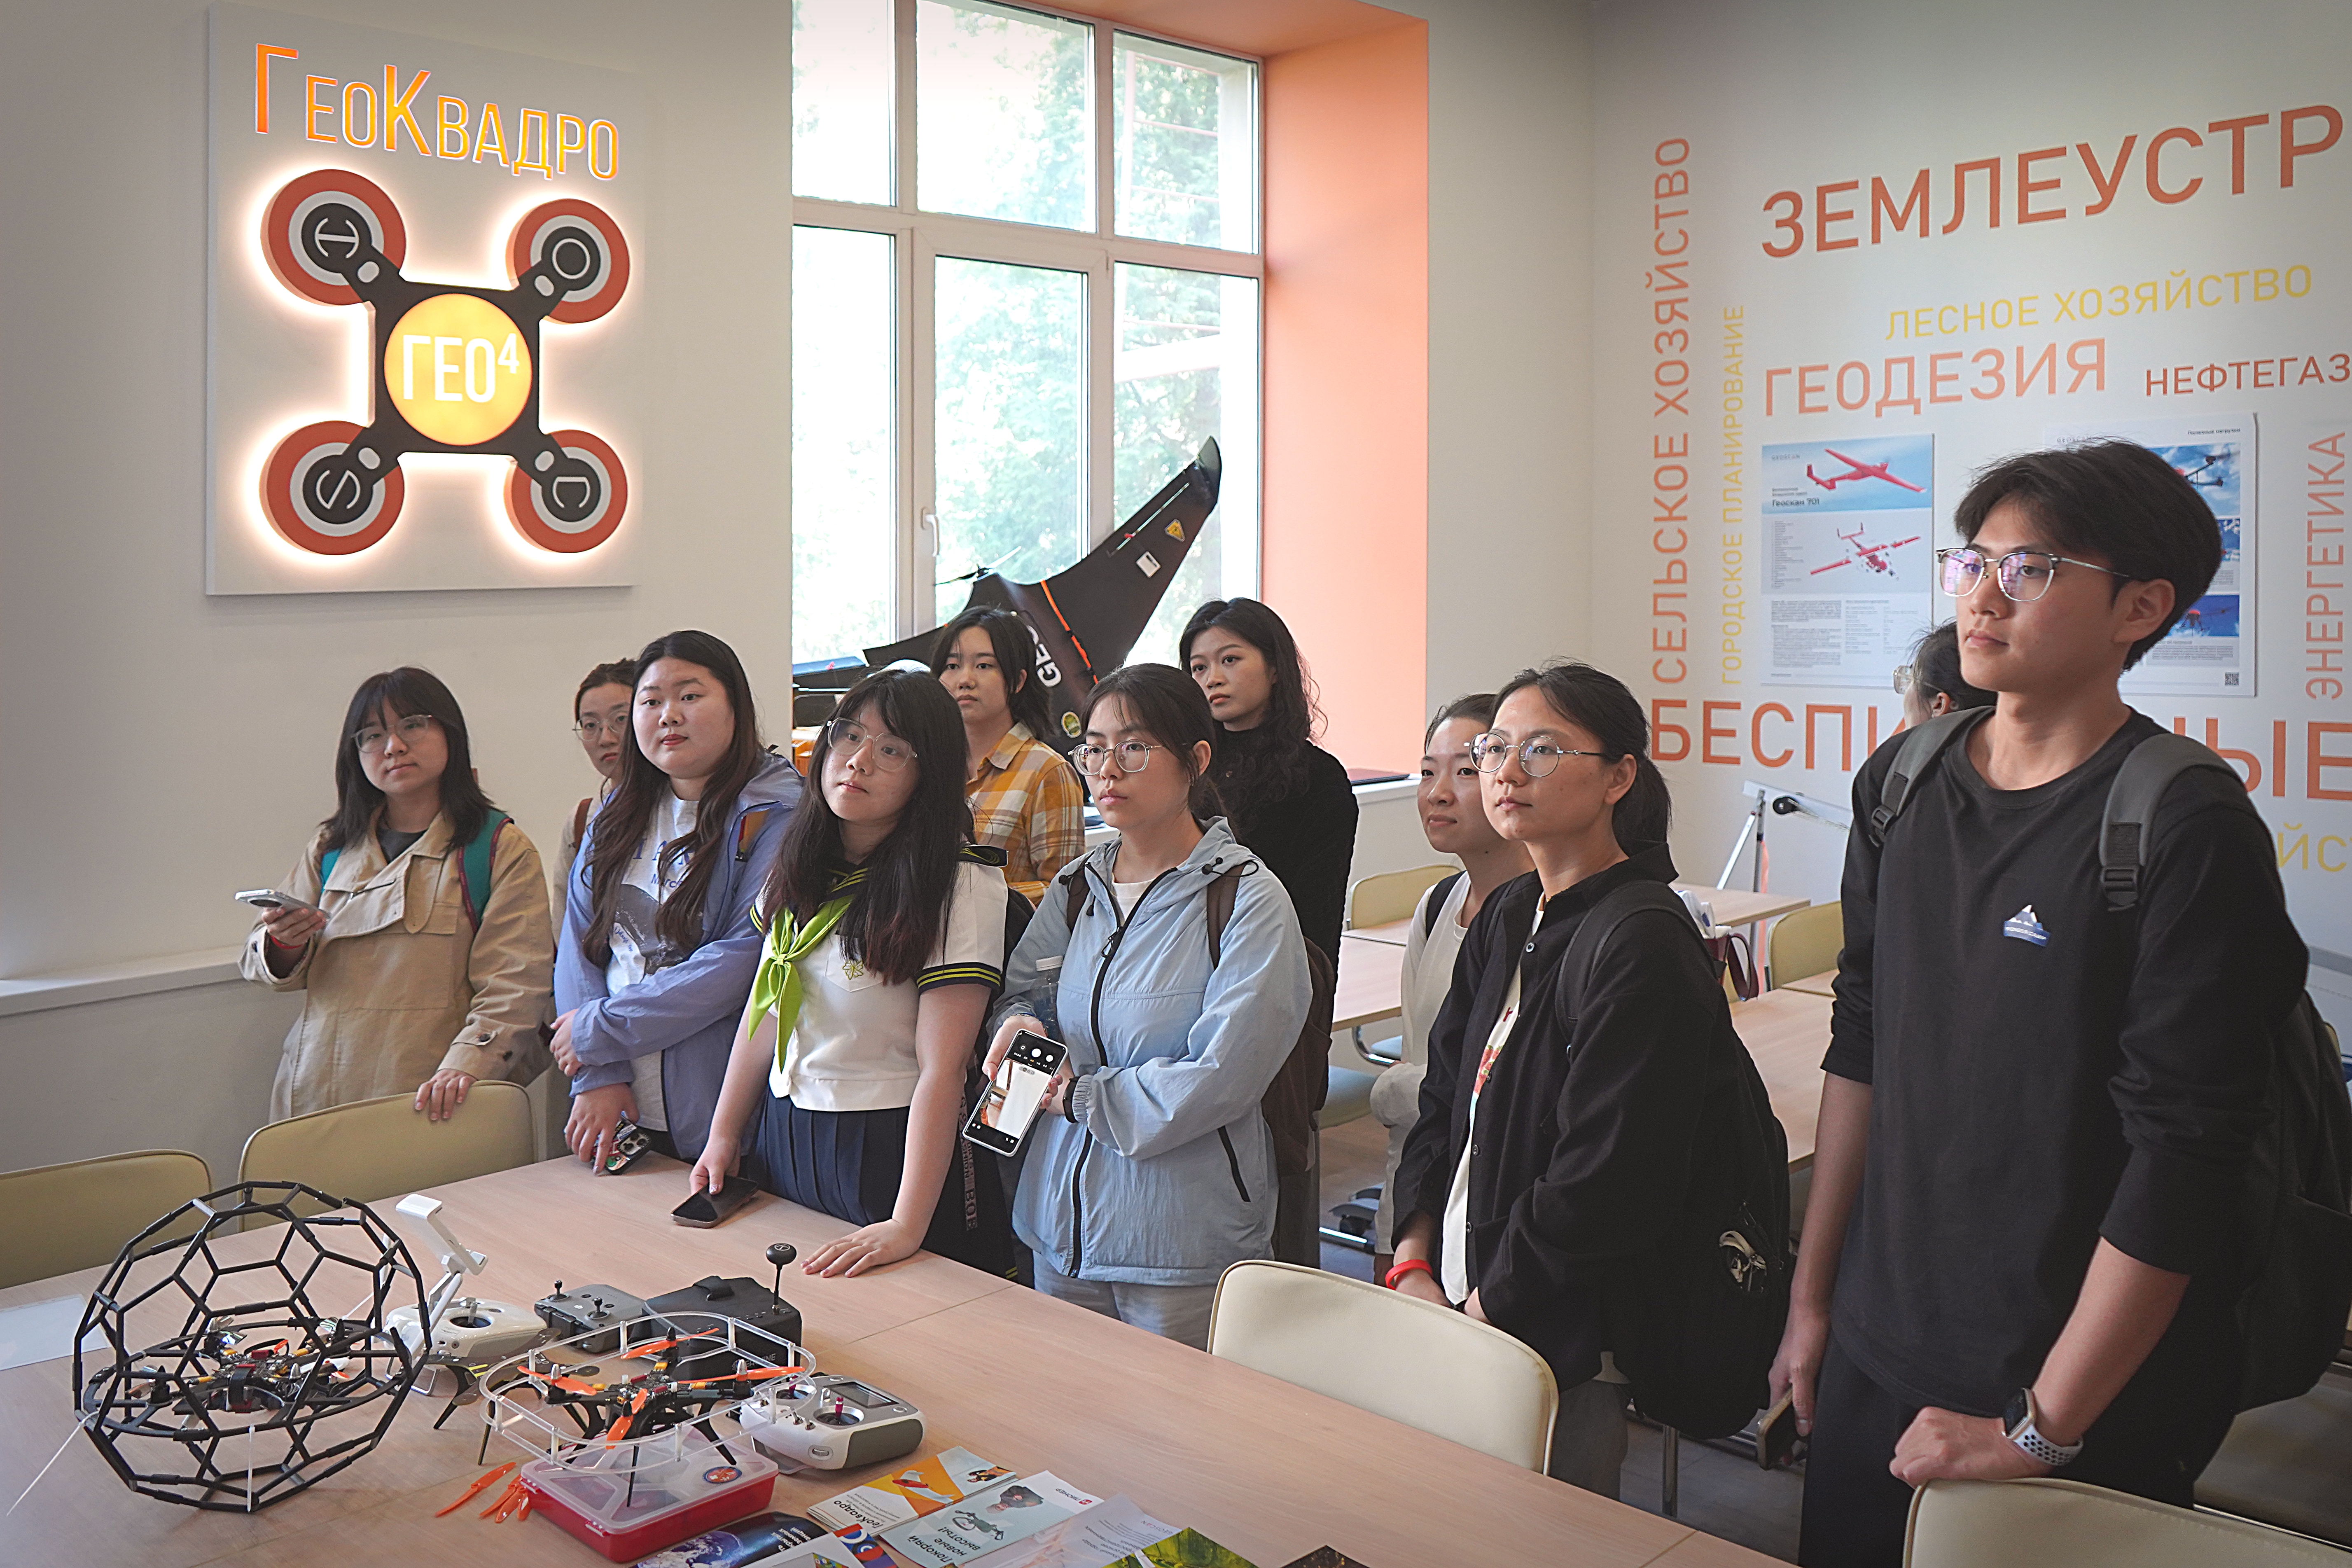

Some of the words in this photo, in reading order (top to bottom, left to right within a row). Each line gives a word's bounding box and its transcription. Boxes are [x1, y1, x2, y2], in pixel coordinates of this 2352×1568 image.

[1761, 104, 2344, 257] ЗЕМЛЕУСТР
[1645, 138, 1689, 417] ХОЗЯЙСТВО
[1885, 294, 2039, 340] ЛЕСНОЕ
[2053, 264, 2313, 323] ХОЗЯЙСТВО
[1723, 305, 1745, 523] ПЛАНИРОВАНИЕ
[1765, 337, 2106, 418] ГЕОДЕЗИЯ
[2146, 353, 2351, 396] НЕФТЕГАЗ
[1652, 432, 1689, 684] СЕЛЬСКОЕ
[2305, 432, 2345, 700] ЭНЕРГЕТИКА
[1722, 533, 1746, 685] ГОРОДСКОЕ
[834, 1500, 884, 1528] ГеоКвадро
[907, 1535, 953, 1563] Покоряй
[934, 1538, 967, 1556] новые
[937, 1527, 981, 1551] высоты!
